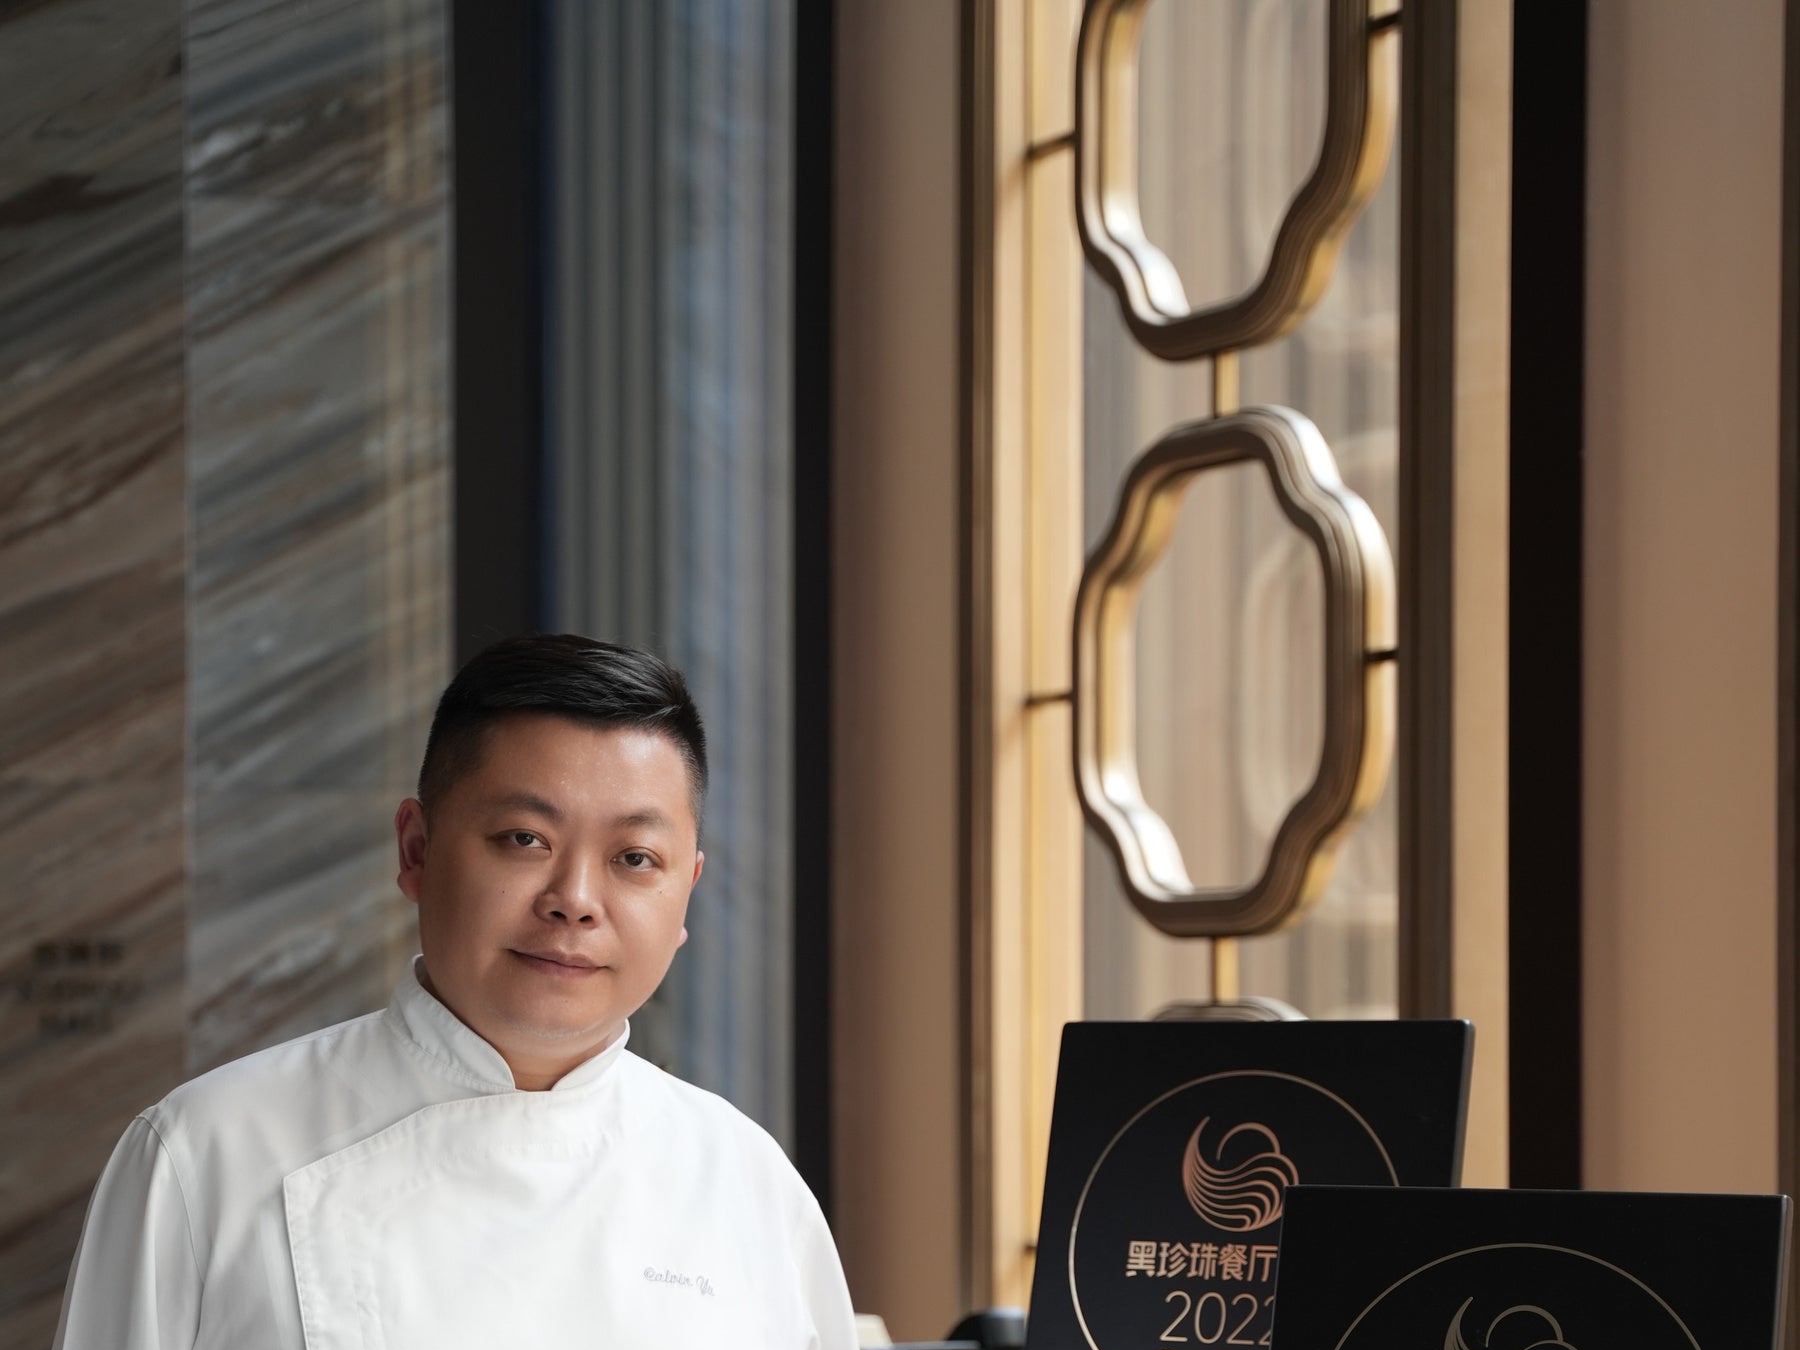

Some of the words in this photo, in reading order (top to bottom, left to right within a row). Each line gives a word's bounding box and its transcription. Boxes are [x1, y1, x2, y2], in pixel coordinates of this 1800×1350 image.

[1125, 1240, 1278, 1283] 黑珍珠餐厅
